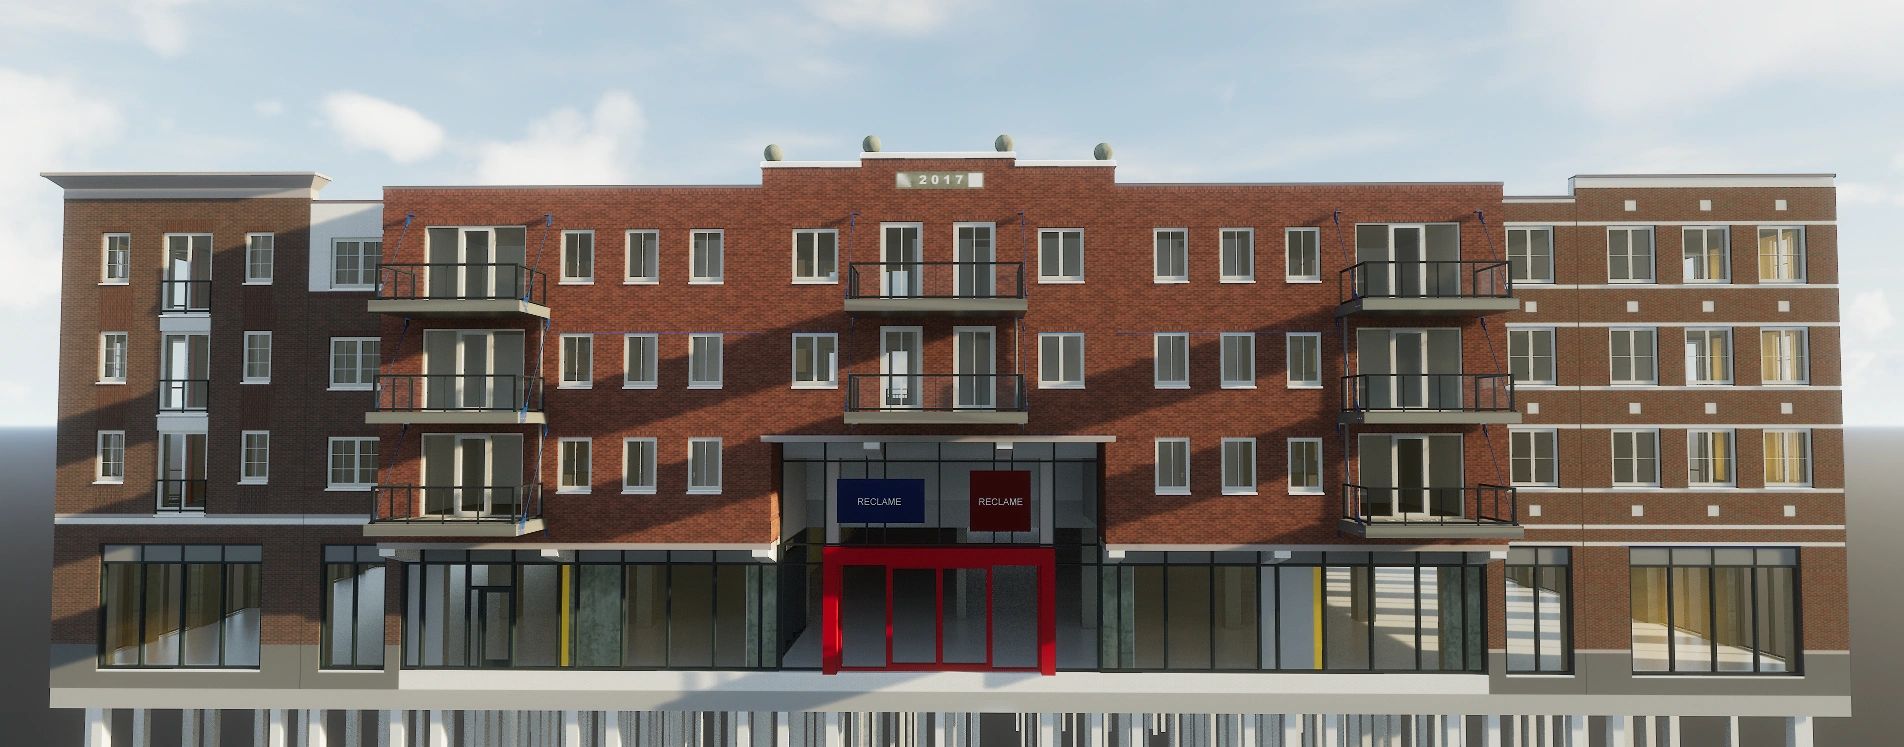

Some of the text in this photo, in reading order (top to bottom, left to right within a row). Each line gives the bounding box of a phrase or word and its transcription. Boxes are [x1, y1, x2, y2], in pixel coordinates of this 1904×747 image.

[919, 174, 963, 185] 2017
[857, 497, 902, 506] RECLAME
[978, 497, 1023, 506] RECLAME
